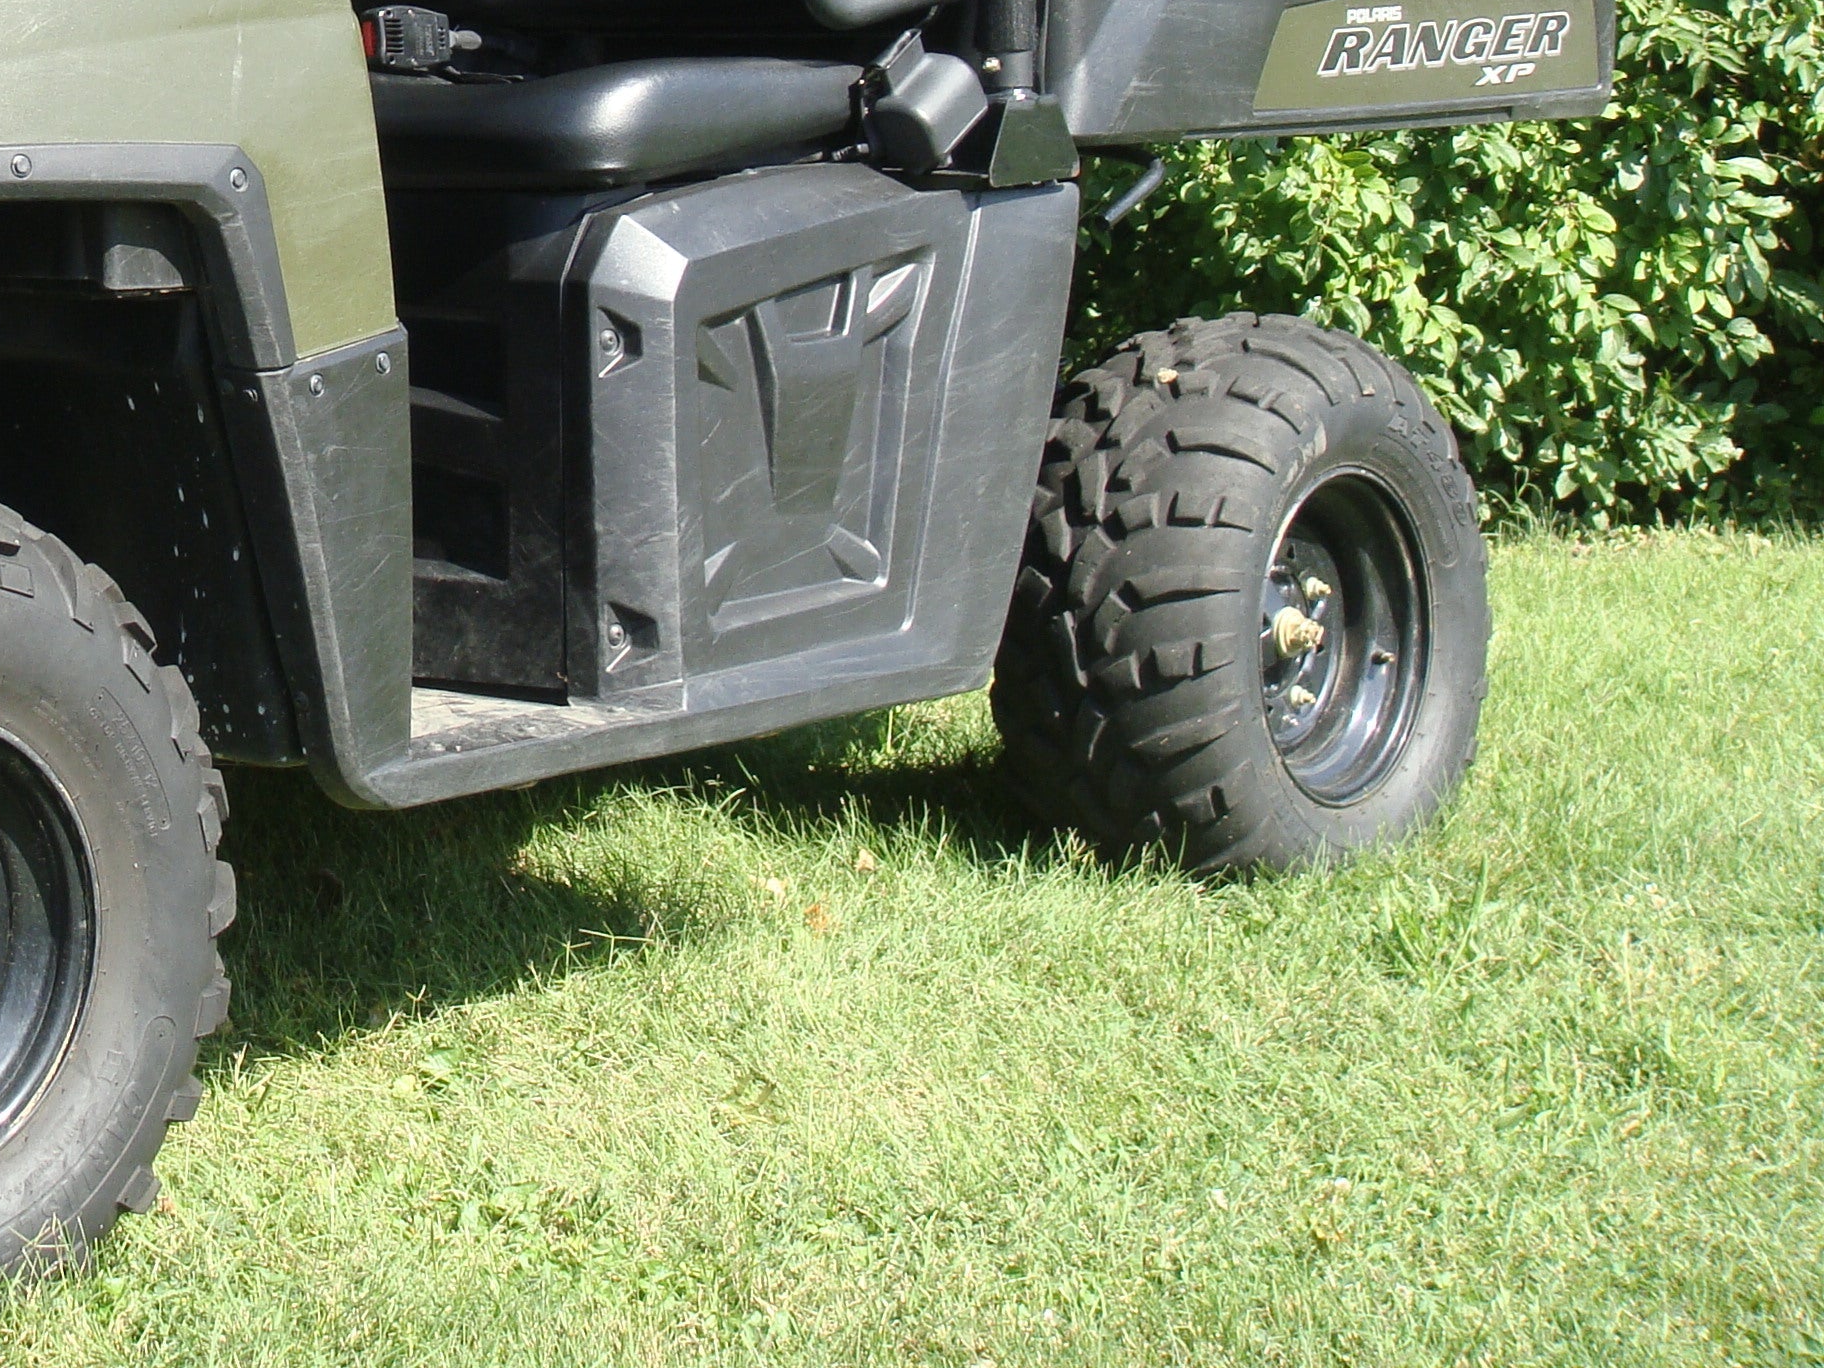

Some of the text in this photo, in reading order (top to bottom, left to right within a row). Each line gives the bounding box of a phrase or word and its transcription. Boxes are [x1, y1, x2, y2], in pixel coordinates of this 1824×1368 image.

[1347, 5, 1402, 25] POLARIS
[1317, 11, 1570, 77] RANGER
[1475, 62, 1536, 86] XP
